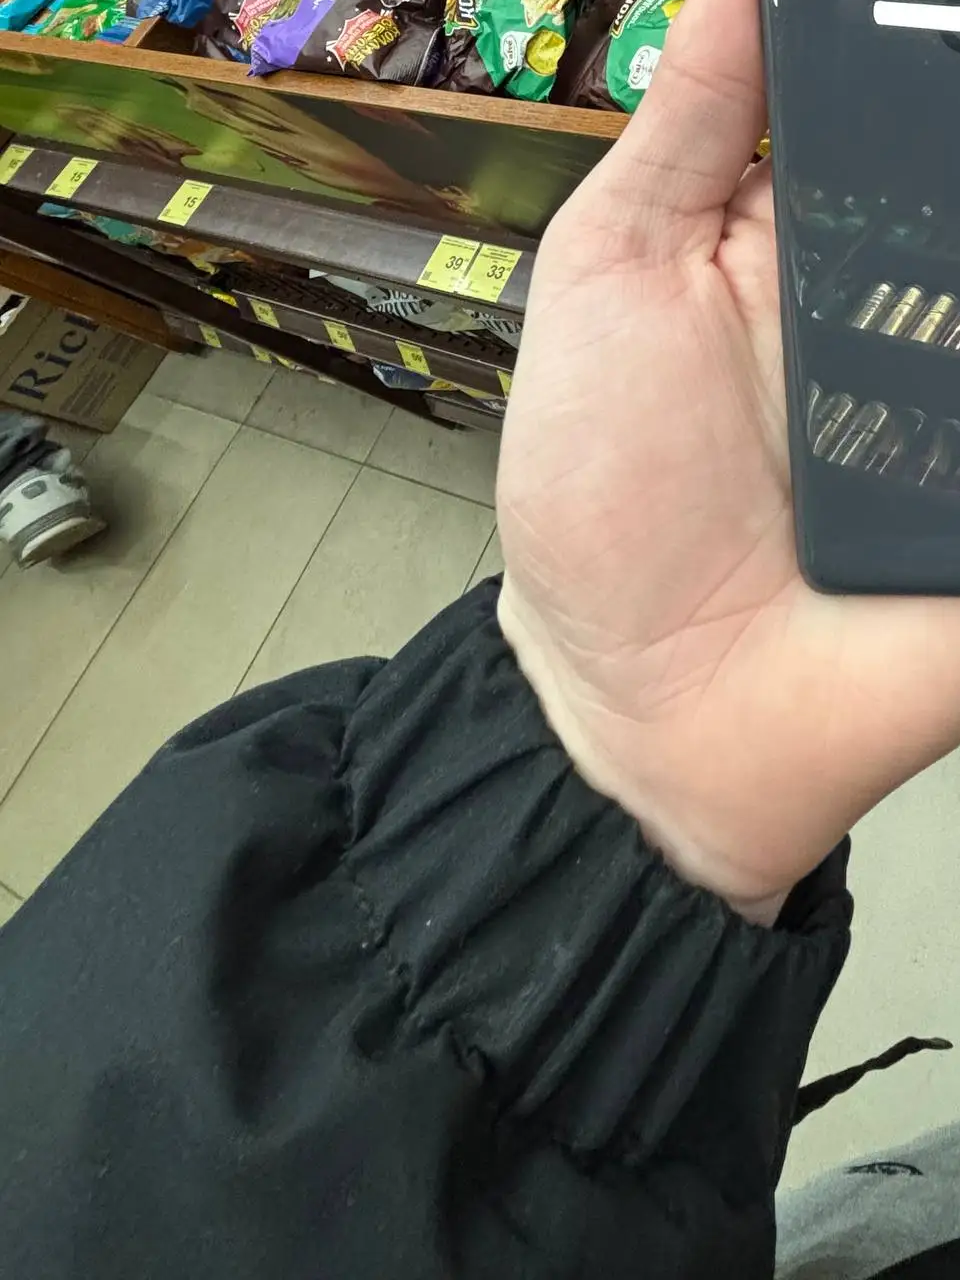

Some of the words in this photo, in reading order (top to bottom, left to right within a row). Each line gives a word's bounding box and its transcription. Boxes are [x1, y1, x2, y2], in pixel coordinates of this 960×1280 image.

[70, 172, 83, 183] 15
[183, 196, 198, 209] 15
[445, 256, 464, 270] 39
[486, 264, 506, 280] 33
